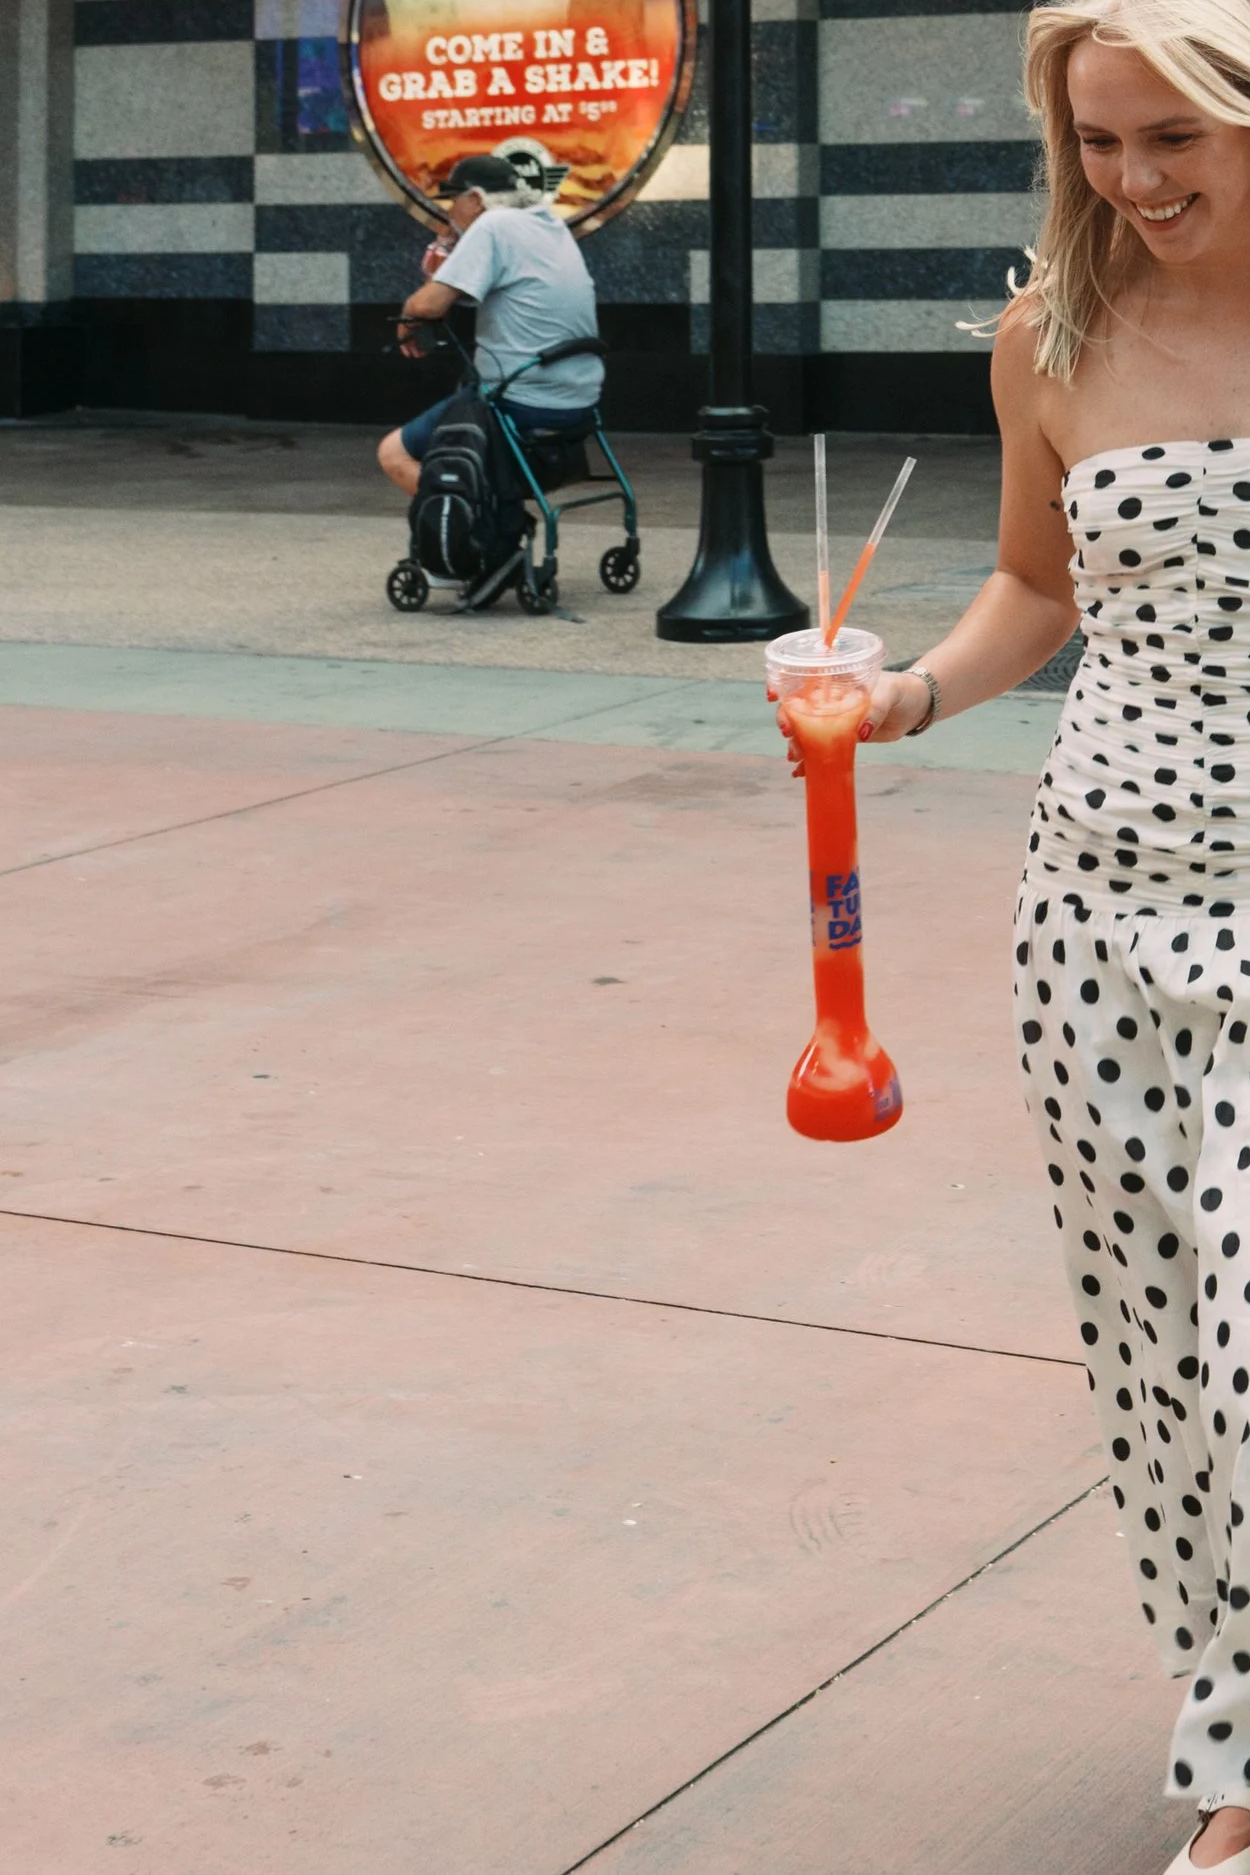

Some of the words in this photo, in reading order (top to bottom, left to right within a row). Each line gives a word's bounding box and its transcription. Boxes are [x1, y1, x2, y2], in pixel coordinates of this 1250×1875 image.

[426, 32, 524, 65] COME
[534, 29, 576, 59] IN
[586, 27, 609, 56] &
[378, 69, 477, 102] GRAB
[487, 67, 516, 96] A
[525, 59, 660, 94] SHAKE!
[421, 104, 536, 130] STARTING
[542, 102, 573, 123] AT
